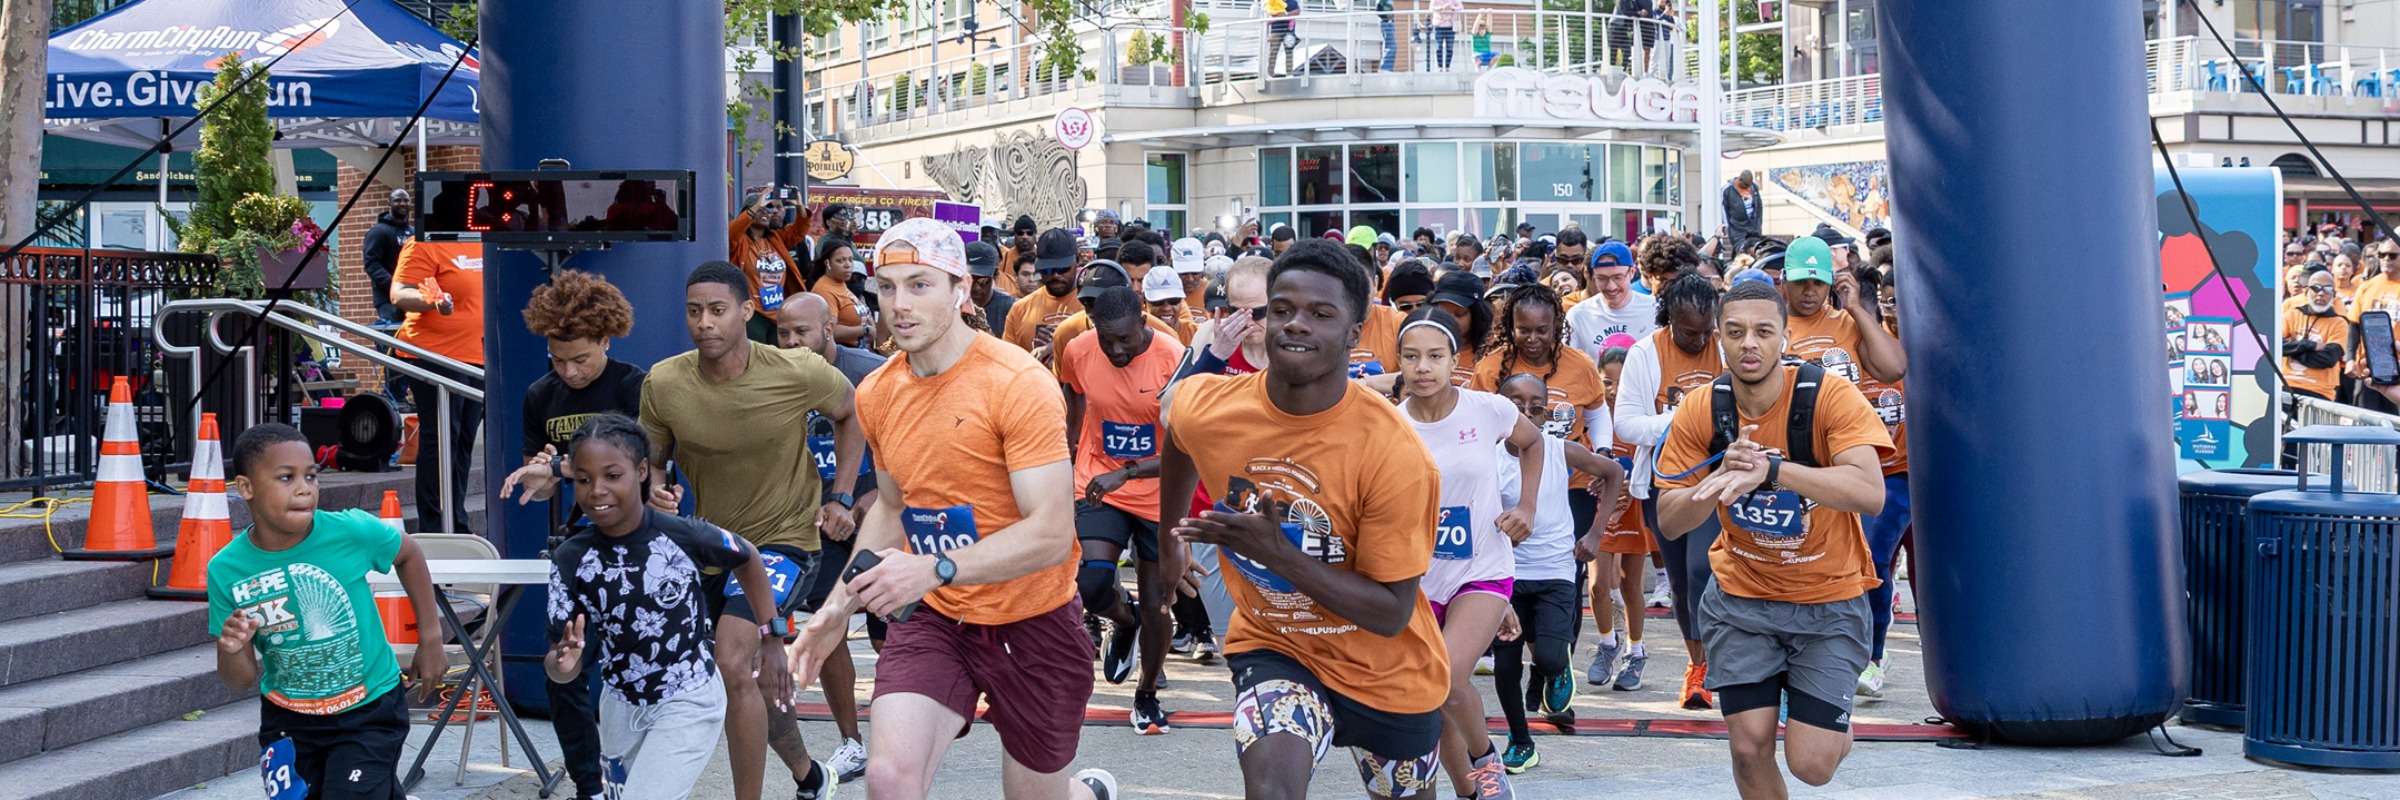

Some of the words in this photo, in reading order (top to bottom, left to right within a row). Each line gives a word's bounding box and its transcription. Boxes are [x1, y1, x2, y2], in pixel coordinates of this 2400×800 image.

[68, 25, 260, 51] CharmCityRun
[136, 170, 195, 181] Sandiches
[807, 160, 846, 173] POTBELLY
[828, 195, 877, 204] GEORGE'S
[1552, 183, 1573, 197] 150
[763, 292, 784, 306] 1644
[1593, 335, 1604, 345] 10
[1603, 325, 1628, 337] MILE
[1874, 405, 1898, 424] PE
[1106, 434, 1151, 451] 1715
[814, 451, 837, 468] 14
[1733, 502, 1795, 527] 1357
[1437, 525, 1467, 546] 70
[765, 566, 788, 592] 71
[245, 596, 296, 627] 5K
[326, 692, 366, 715] 06.01.24
[267, 764, 291, 798] 69
